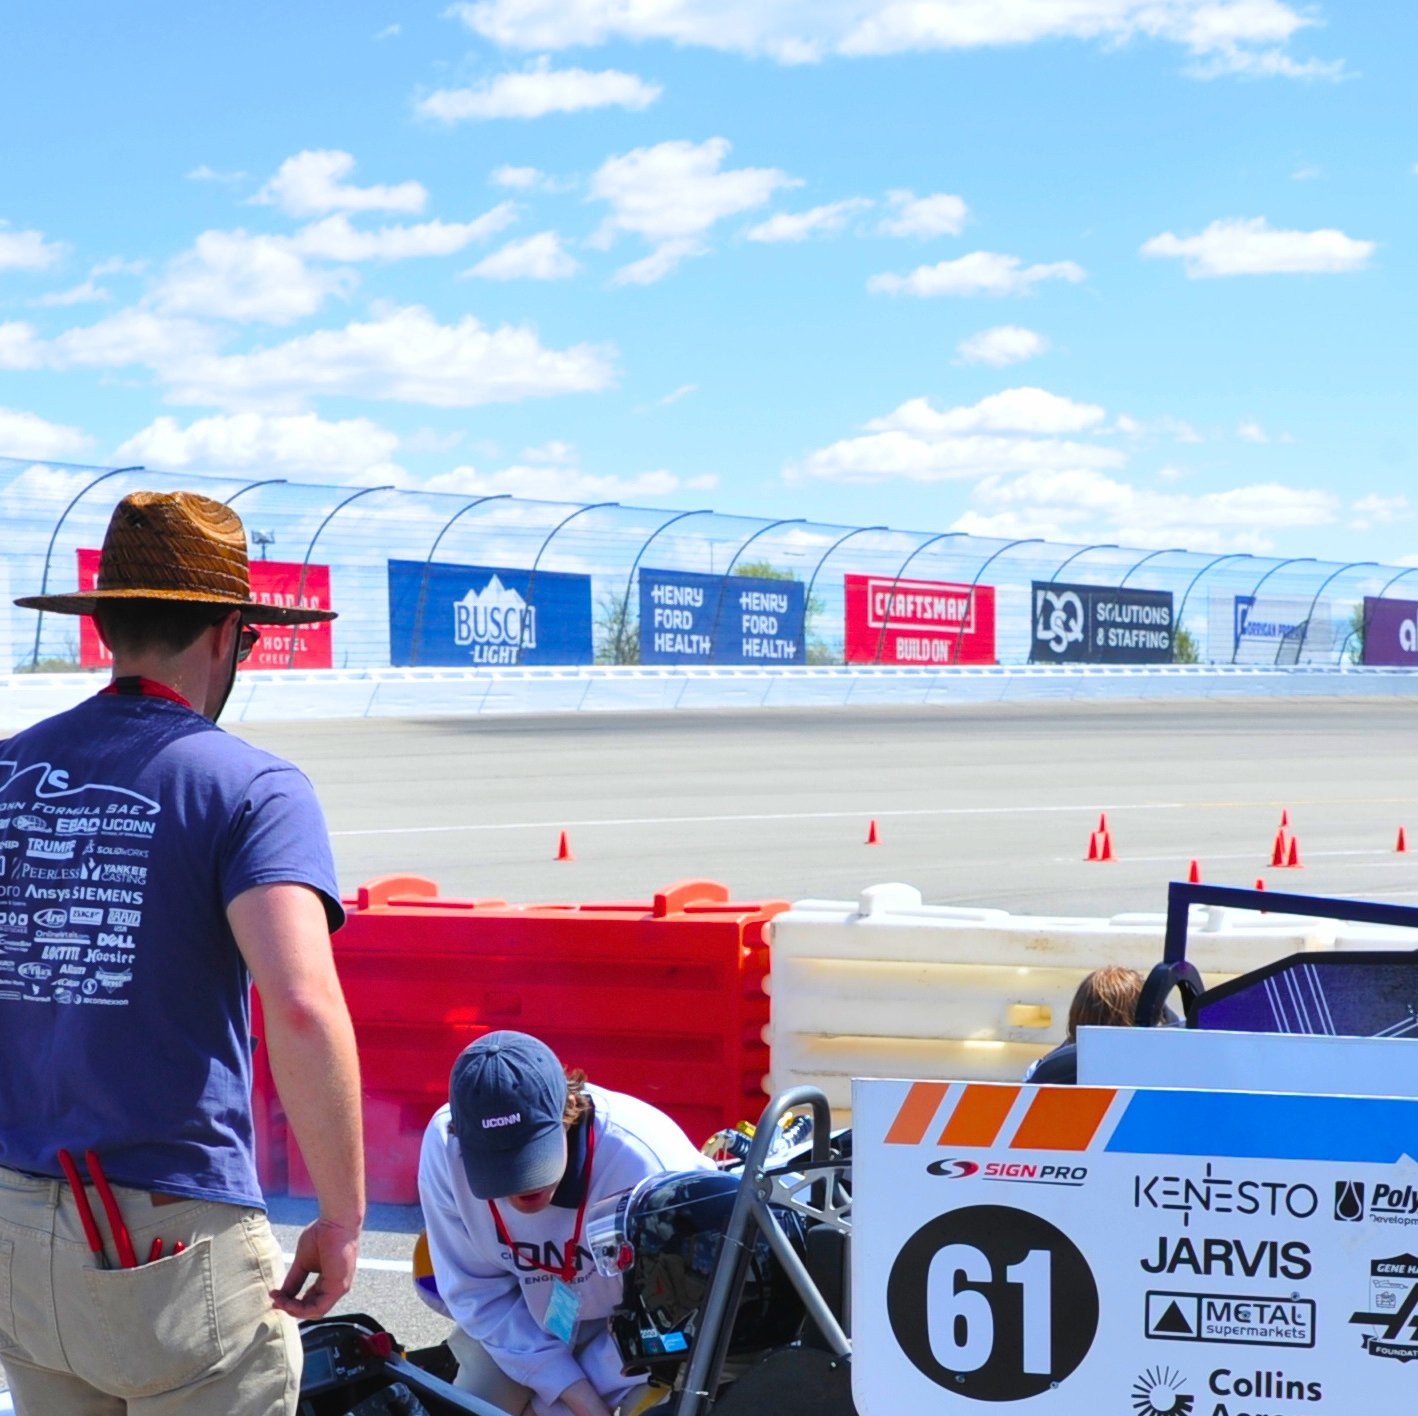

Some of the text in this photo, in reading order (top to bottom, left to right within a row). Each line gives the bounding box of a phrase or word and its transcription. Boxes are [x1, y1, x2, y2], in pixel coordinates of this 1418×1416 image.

[651, 584, 703, 607] HENRY
[740, 591, 788, 612] HENRY
[875, 593, 969, 622] CRAFTSMAN
[1096, 602, 1171, 626] SOLUTIONS
[455, 603, 536, 648] BUSCH
[654, 609, 693, 630] FORD
[743, 614, 778, 634] FORD
[263, 638, 308, 652] HOTEL
[654, 632, 711, 655] HEALTH
[743, 637, 796, 659] HEALTH
[896, 637, 928, 661] BUILD
[1108, 632, 1171, 650] STAFFING
[470, 645, 520, 664] LIGHT
[31, 802, 101, 815] FORMULA
[106, 804, 144, 815] SAE
[102, 818, 156, 834] UCONN
[96, 845, 149, 858] SOLIDWORKS
[22, 863, 81, 880] PEERLESS
[101, 873, 147, 885] CASTING
[103, 865, 148, 877] YANKEE
[25, 884, 70, 902] Ansys
[71, 886, 144, 905] SIEMENS
[97, 933, 136, 948] DELL
[482, 1113, 521, 1129] UCONN
[983, 1162, 1088, 1180] SIGN PRO
[1135, 1163, 1319, 1226] KENESTO
[1140, 1237, 1312, 1281] JARVIS
[1377, 1263, 1405, 1274] GENE
[926, 1243, 1052, 1376] 61
[1206, 1300, 1306, 1328] METAL
[1206, 1323, 1307, 1341] supermarkets
[1208, 1368, 1323, 1402] Collins
